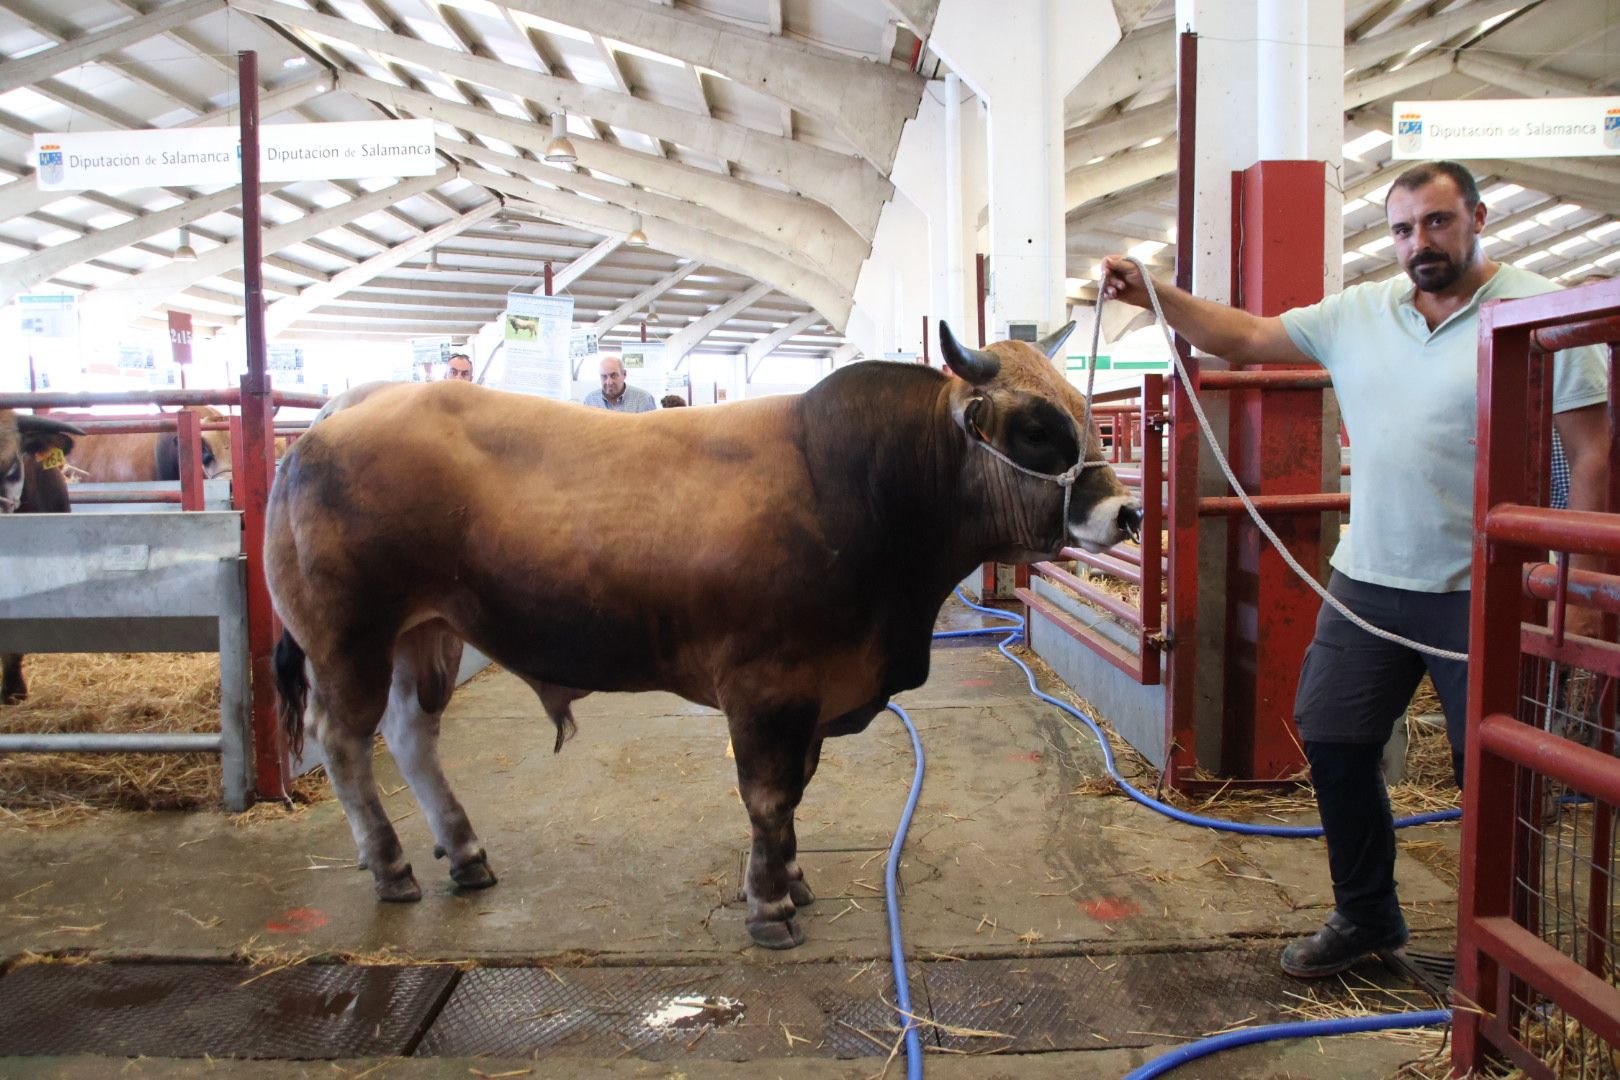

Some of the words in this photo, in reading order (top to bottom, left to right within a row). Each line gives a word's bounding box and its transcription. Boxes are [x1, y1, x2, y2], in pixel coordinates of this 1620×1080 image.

[1429, 121, 1502, 139] Diputación
[1508, 127, 1520, 136] de
[1526, 121, 1597, 136] Salamanca
[69, 153, 140, 170] Diputación
[145, 156, 157, 166] de
[161, 150, 230, 165] Salamanca
[267, 146, 339, 163] Diputación
[344, 147, 356, 158] de
[360, 143, 431, 157] Salamanca
